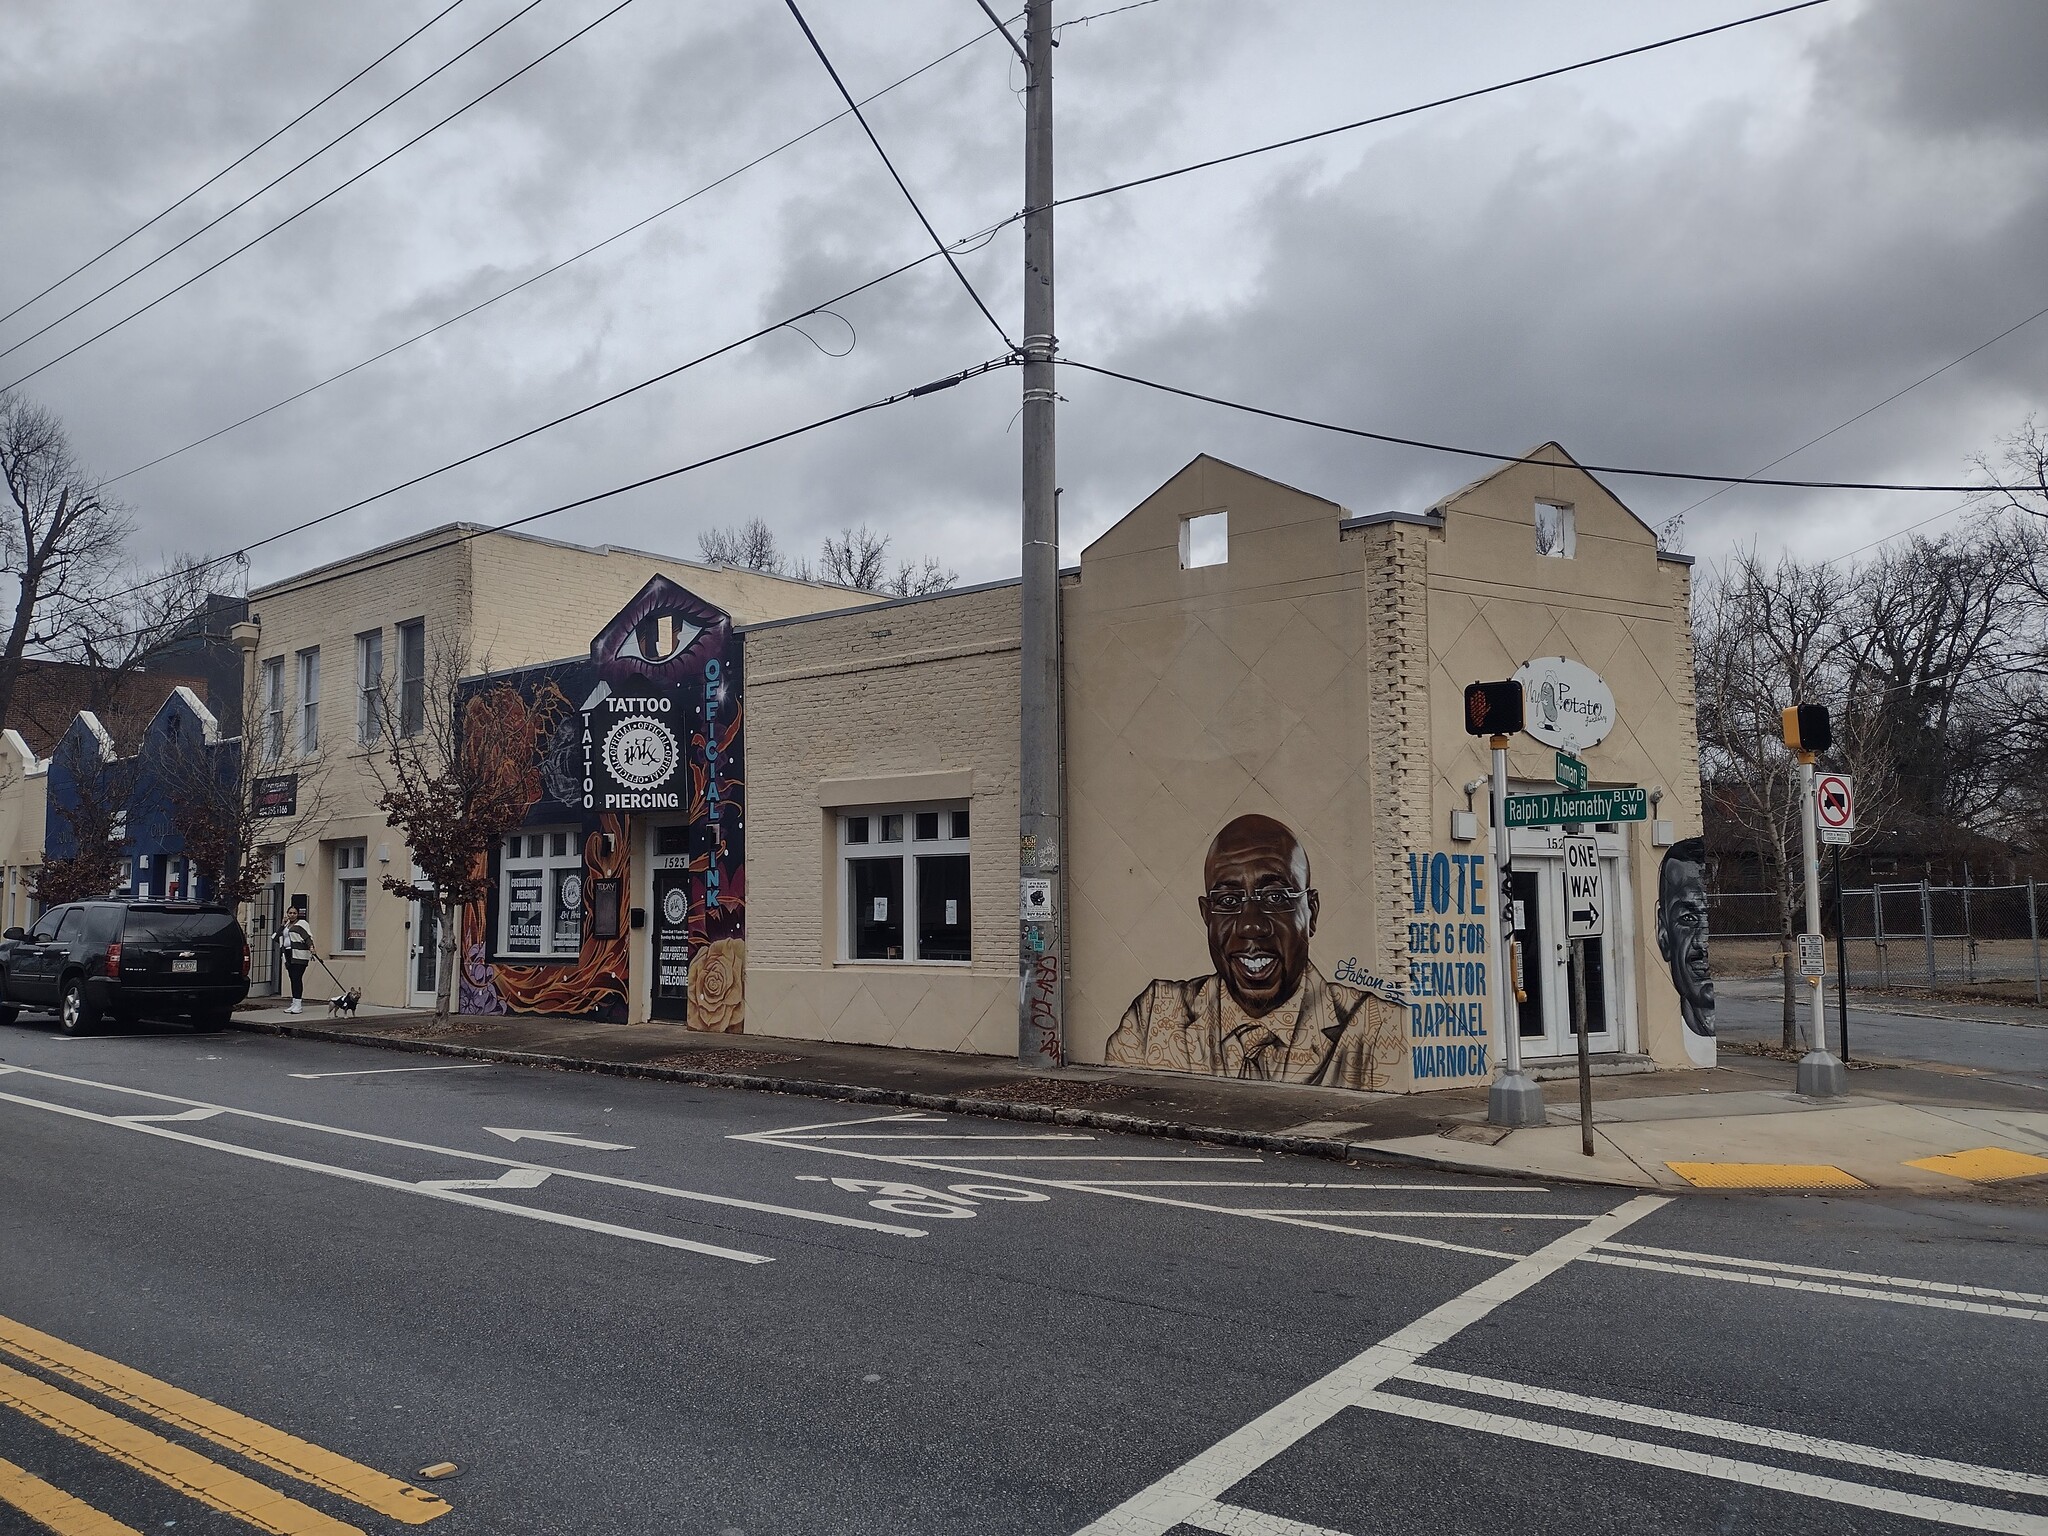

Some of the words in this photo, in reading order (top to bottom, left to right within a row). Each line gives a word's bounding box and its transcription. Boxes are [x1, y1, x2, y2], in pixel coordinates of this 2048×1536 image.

[606, 697, 671, 712] TATTOO
[1559, 682, 1603, 717] Potato
[610, 724, 635, 756] OFFICIAL
[638, 722, 670, 747] OFFICIAL
[705, 658, 721, 820] OFFICIAL
[582, 712, 594, 808] TATTOO
[612, 760, 645, 783] OFFICIAL
[650, 750, 672, 782] OFFICIAL
[1557, 756, 1578, 785] Inman
[1580, 765, 1587, 777] ST
[605, 793, 679, 808] PIERCING
[1509, 799, 1538, 824] Ralph
[1542, 798, 1549, 818] D
[1553, 794, 1612, 820] Abernathy
[1613, 790, 1644, 802] BLVD
[1621, 804, 1637, 816] SW
[1547, 838, 1564, 849] 152
[1568, 845, 1597, 867] ONE
[664, 857, 685, 868] 1523
[511, 878, 527, 887] CUSTOM
[597, 882, 616, 891] TODAY
[706, 852, 720, 907] INK
[1409, 852, 1485, 915] VOTE
[1571, 875, 1598, 898] WAY
[510, 902, 527, 911] SUPPLIES
[517, 890, 537, 899] PIERCINGS
[1409, 923, 1440, 954] DEC
[1444, 923, 1455, 954] 6
[1459, 923, 1485, 954] FOR
[659, 976, 688, 987] WELCOME
[661, 966, 688, 976] WALK-INS
[1335, 957, 1384, 989] Fabian
[1409, 961, 1486, 997] SENATOR
[1412, 1002, 1487, 1037] RAPHAEL
[1412, 1044, 1488, 1079] WARNOCK
